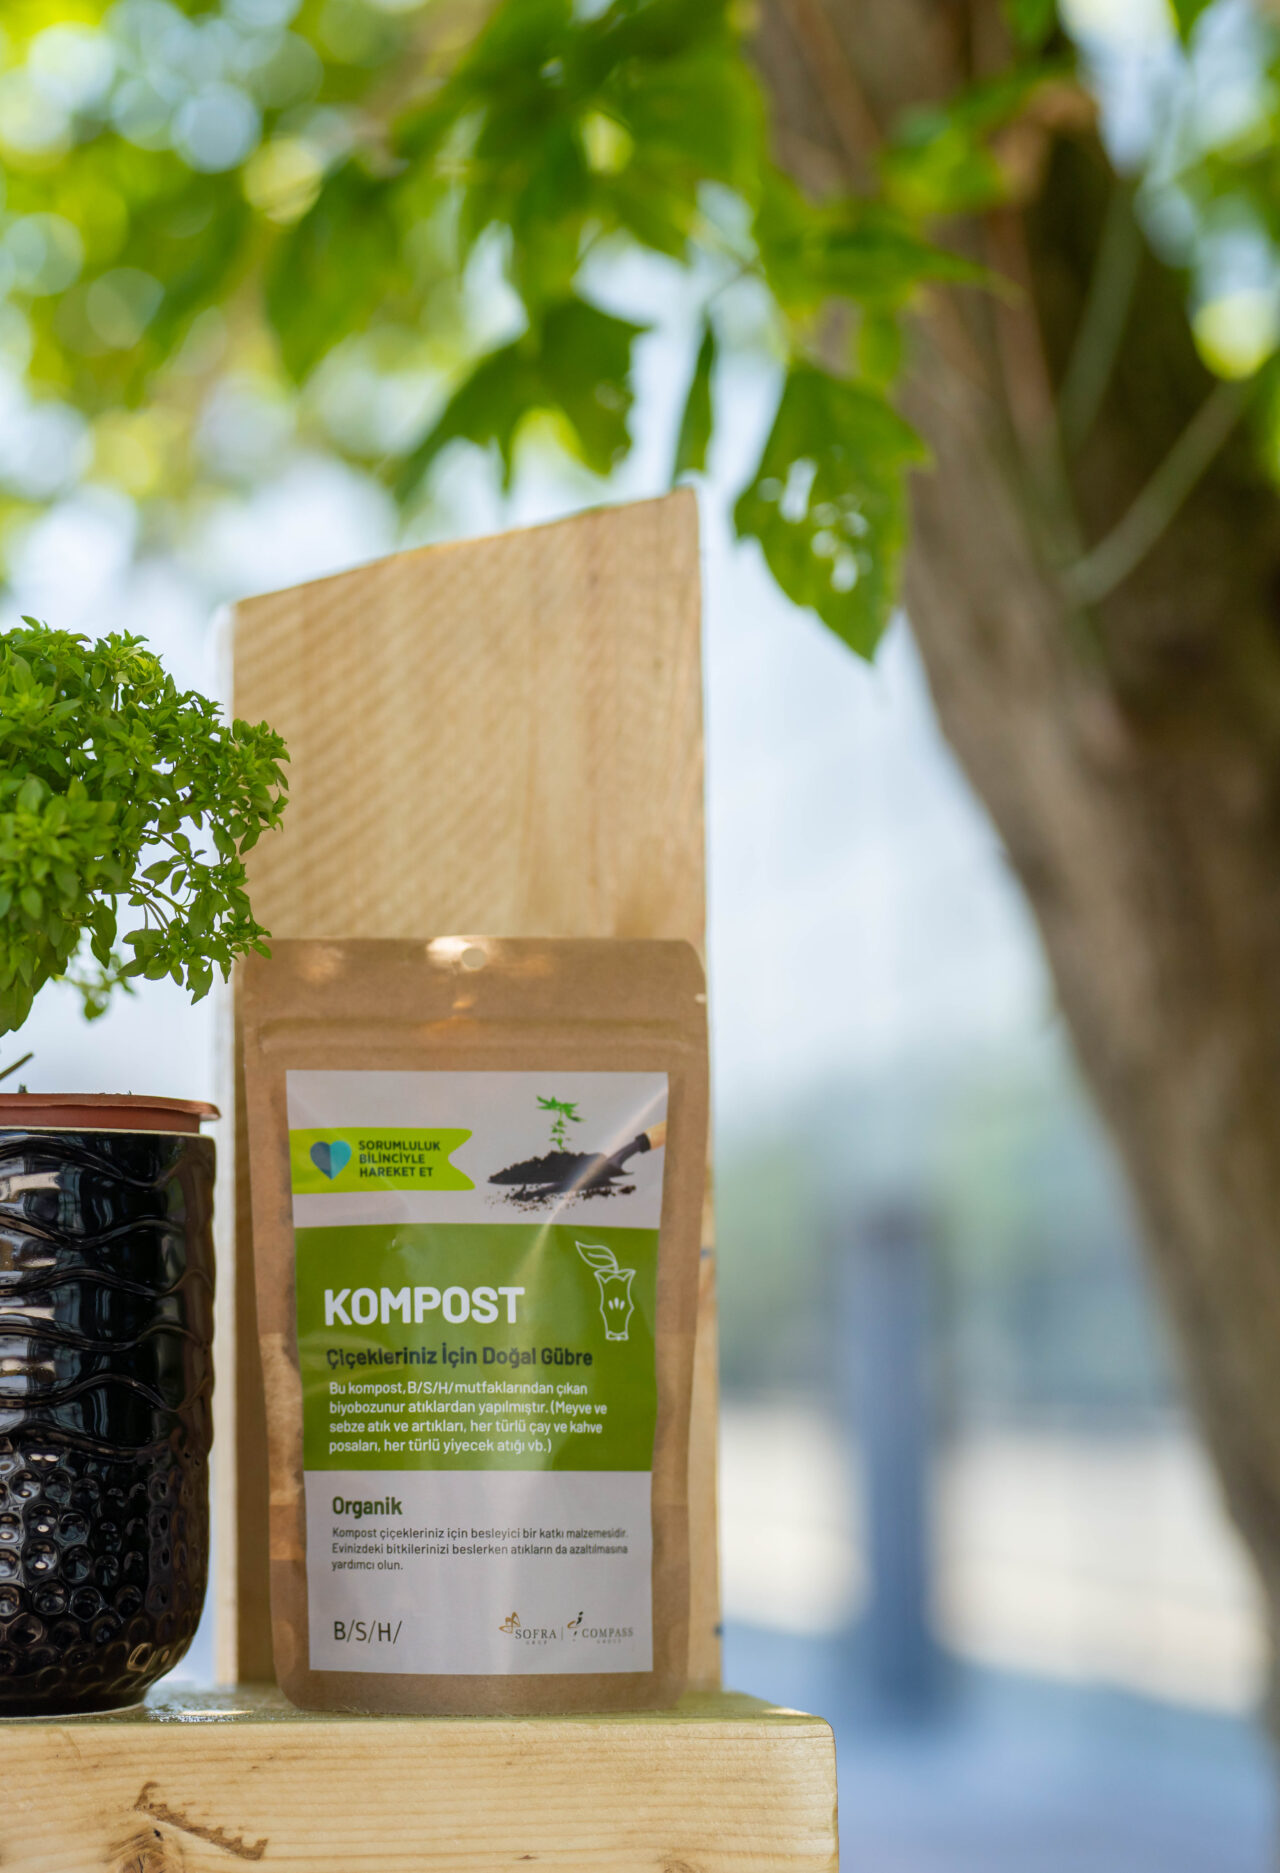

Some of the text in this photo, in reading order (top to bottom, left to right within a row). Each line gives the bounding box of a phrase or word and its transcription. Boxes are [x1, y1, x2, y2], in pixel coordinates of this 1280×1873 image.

[358, 1140, 440, 1151] SORUMLULUK
[359, 1151, 425, 1164] BİLİNCİYLE
[360, 1166, 433, 1177] HAREKET ET
[324, 1286, 525, 1326] KOMPOST
[326, 1342, 593, 1370] Çiçekleriniz İçin Doğal Gübre
[329, 1382, 346, 1395] Bu
[348, 1381, 406, 1397] kompost,
[556, 1382, 588, 1397] çıkan
[329, 1401, 406, 1416] biyobozunur
[408, 1400, 476, 1413] atıklardan
[550, 1400, 592, 1417] (Meyve
[594, 1405, 608, 1415] ve
[329, 1419, 603, 1436] sebze atık ve artıkları, her türlü çay ve kahve
[329, 1438, 552, 1455] posaları, her türlü yiyecek atığı vb.)
[332, 1496, 403, 1519] Organik
[332, 1528, 377, 1539] Kompost
[379, 1528, 445, 1541] çiçekleriniz
[447, 1528, 468, 1541] için
[471, 1528, 520, 1541] besleyici
[522, 1528, 537, 1539] bir
[539, 1528, 564, 1539] katkı
[331, 1543, 384, 1554] Evinizdeki
[386, 1543, 449, 1555] bitkilerinizi
[452, 1543, 508, 1555] beslerken
[510, 1544, 553, 1555] atıkların
[555, 1544, 568, 1555] da
[331, 1560, 404, 1572] yardımcı olun.
[334, 1619, 403, 1645] B/S/H/
[515, 1629, 557, 1640] SOFRA
[581, 1627, 634, 1639] COMPASS
